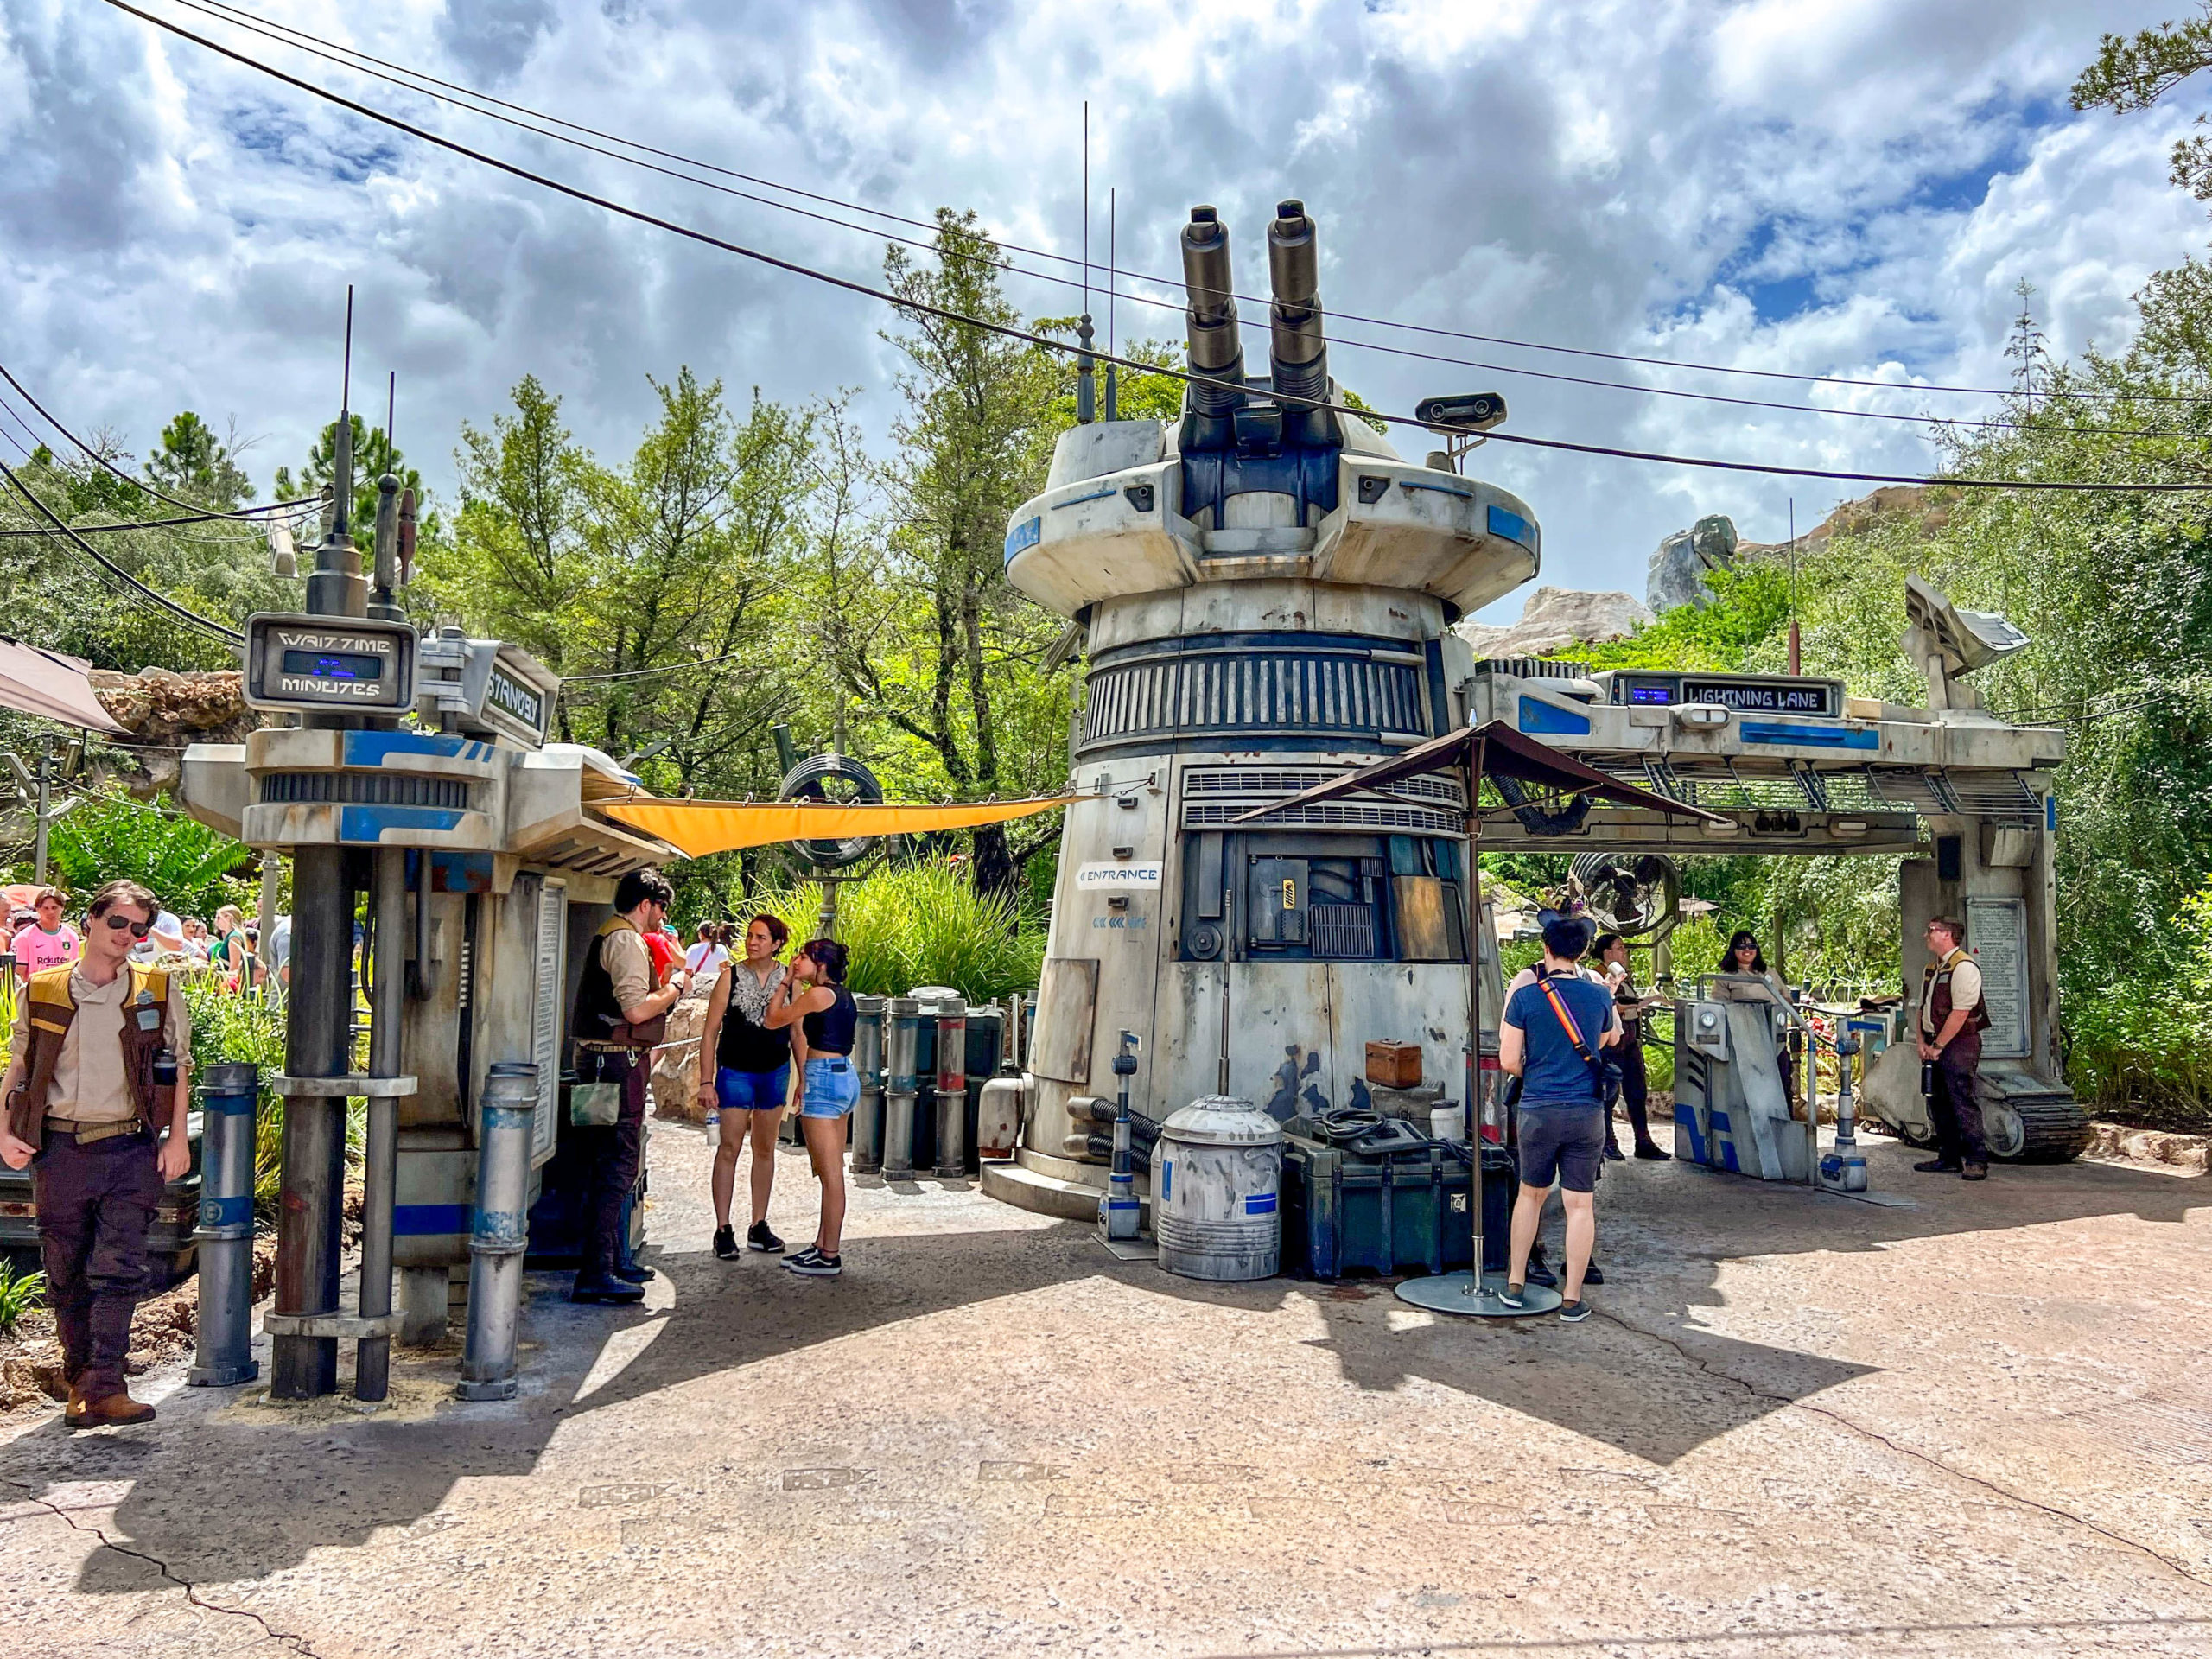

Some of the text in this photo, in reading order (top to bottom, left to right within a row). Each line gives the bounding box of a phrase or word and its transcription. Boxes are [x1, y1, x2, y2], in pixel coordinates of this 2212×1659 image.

[277, 632, 391, 653] WAIT TIME
[281, 677, 381, 696] MINUTES
[488, 671, 538, 723] STANDBY
[1688, 688, 1818, 708] LIGHTNING LANE
[1087, 869, 1158, 881] ENTRANCE
